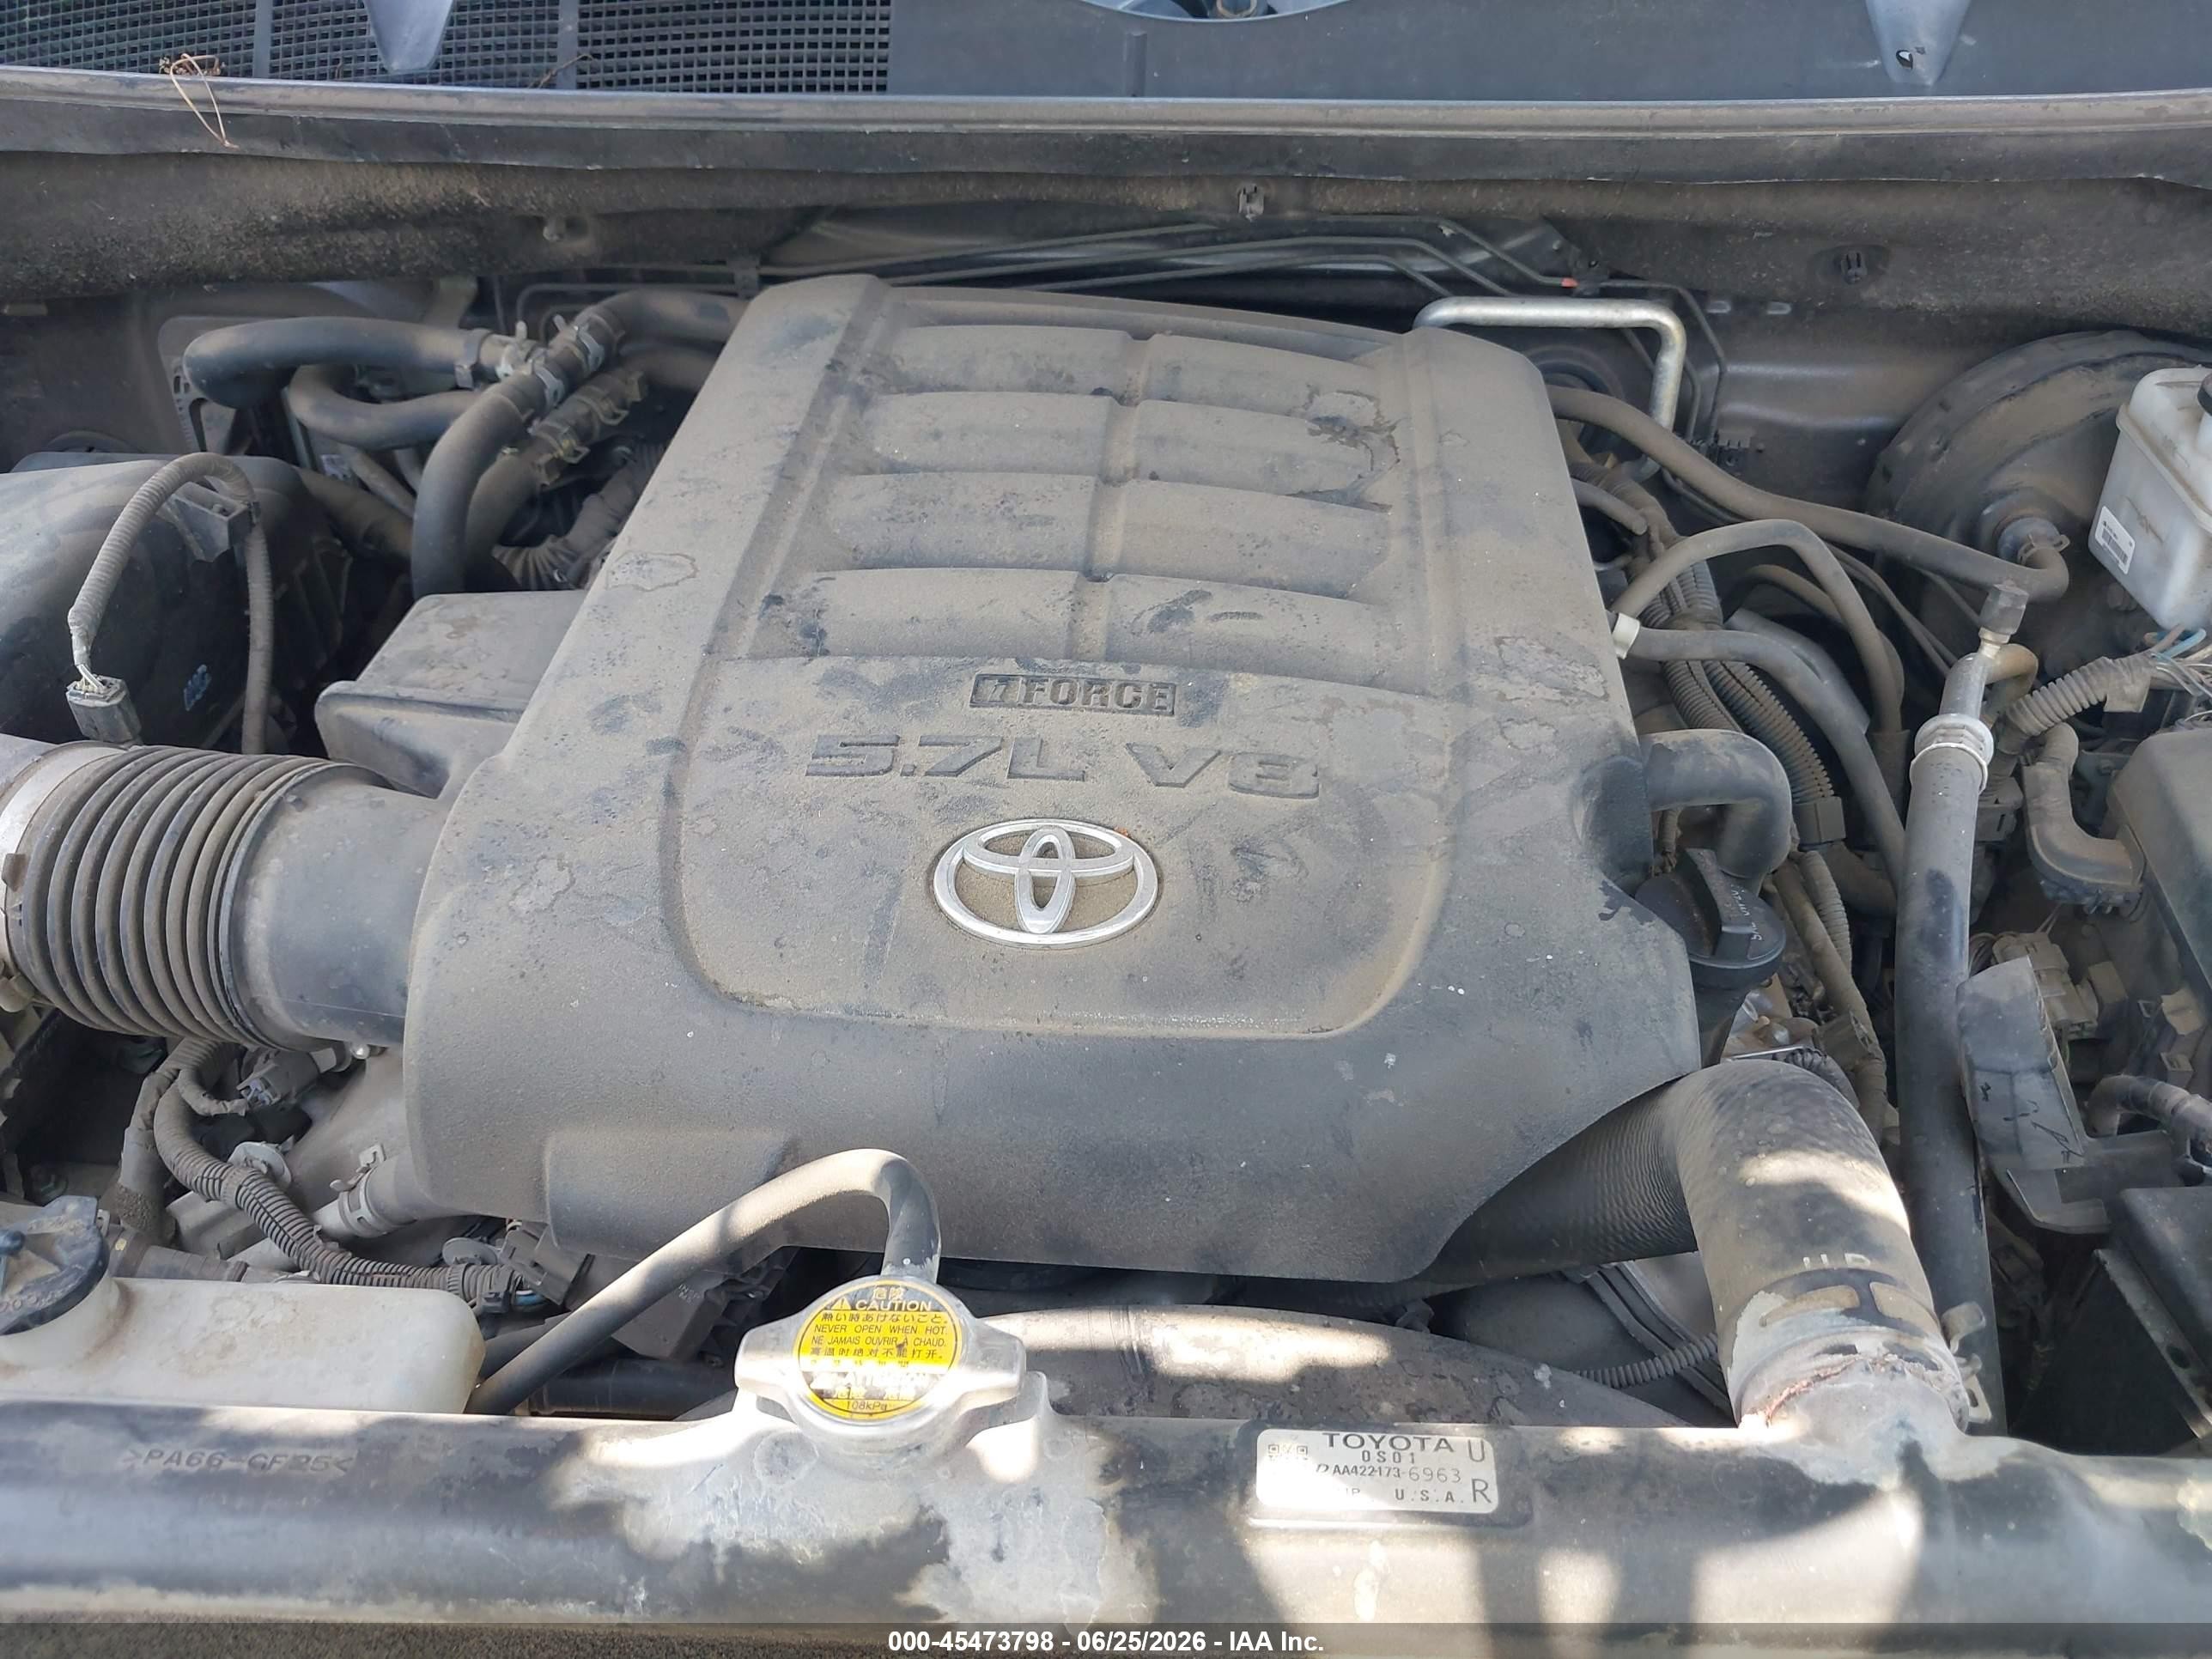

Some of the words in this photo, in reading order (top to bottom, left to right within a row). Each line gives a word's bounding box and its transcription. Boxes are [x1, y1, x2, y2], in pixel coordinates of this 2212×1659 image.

[805, 734, 1086, 781] 5.7L
[1124, 742, 1319, 799] V8
[855, 1300, 932, 1312] CAUTION
[814, 1324, 847, 1334] NEVER
[854, 1325, 882, 1334] OPEN
[889, 1325, 918, 1334] WHEN
[925, 1326, 948, 1335] HOT.
[811, 1335, 824, 1345] NE
[827, 1335, 860, 1346] JAMAIS
[865, 1336, 898, 1346] OUVRIR
[913, 1337, 947, 1347] CHAUD.
[1322, 1432, 1455, 1453] TOYOTA
[1468, 1439, 1486, 1462] U
[1471, 1477, 1492, 1504] R
